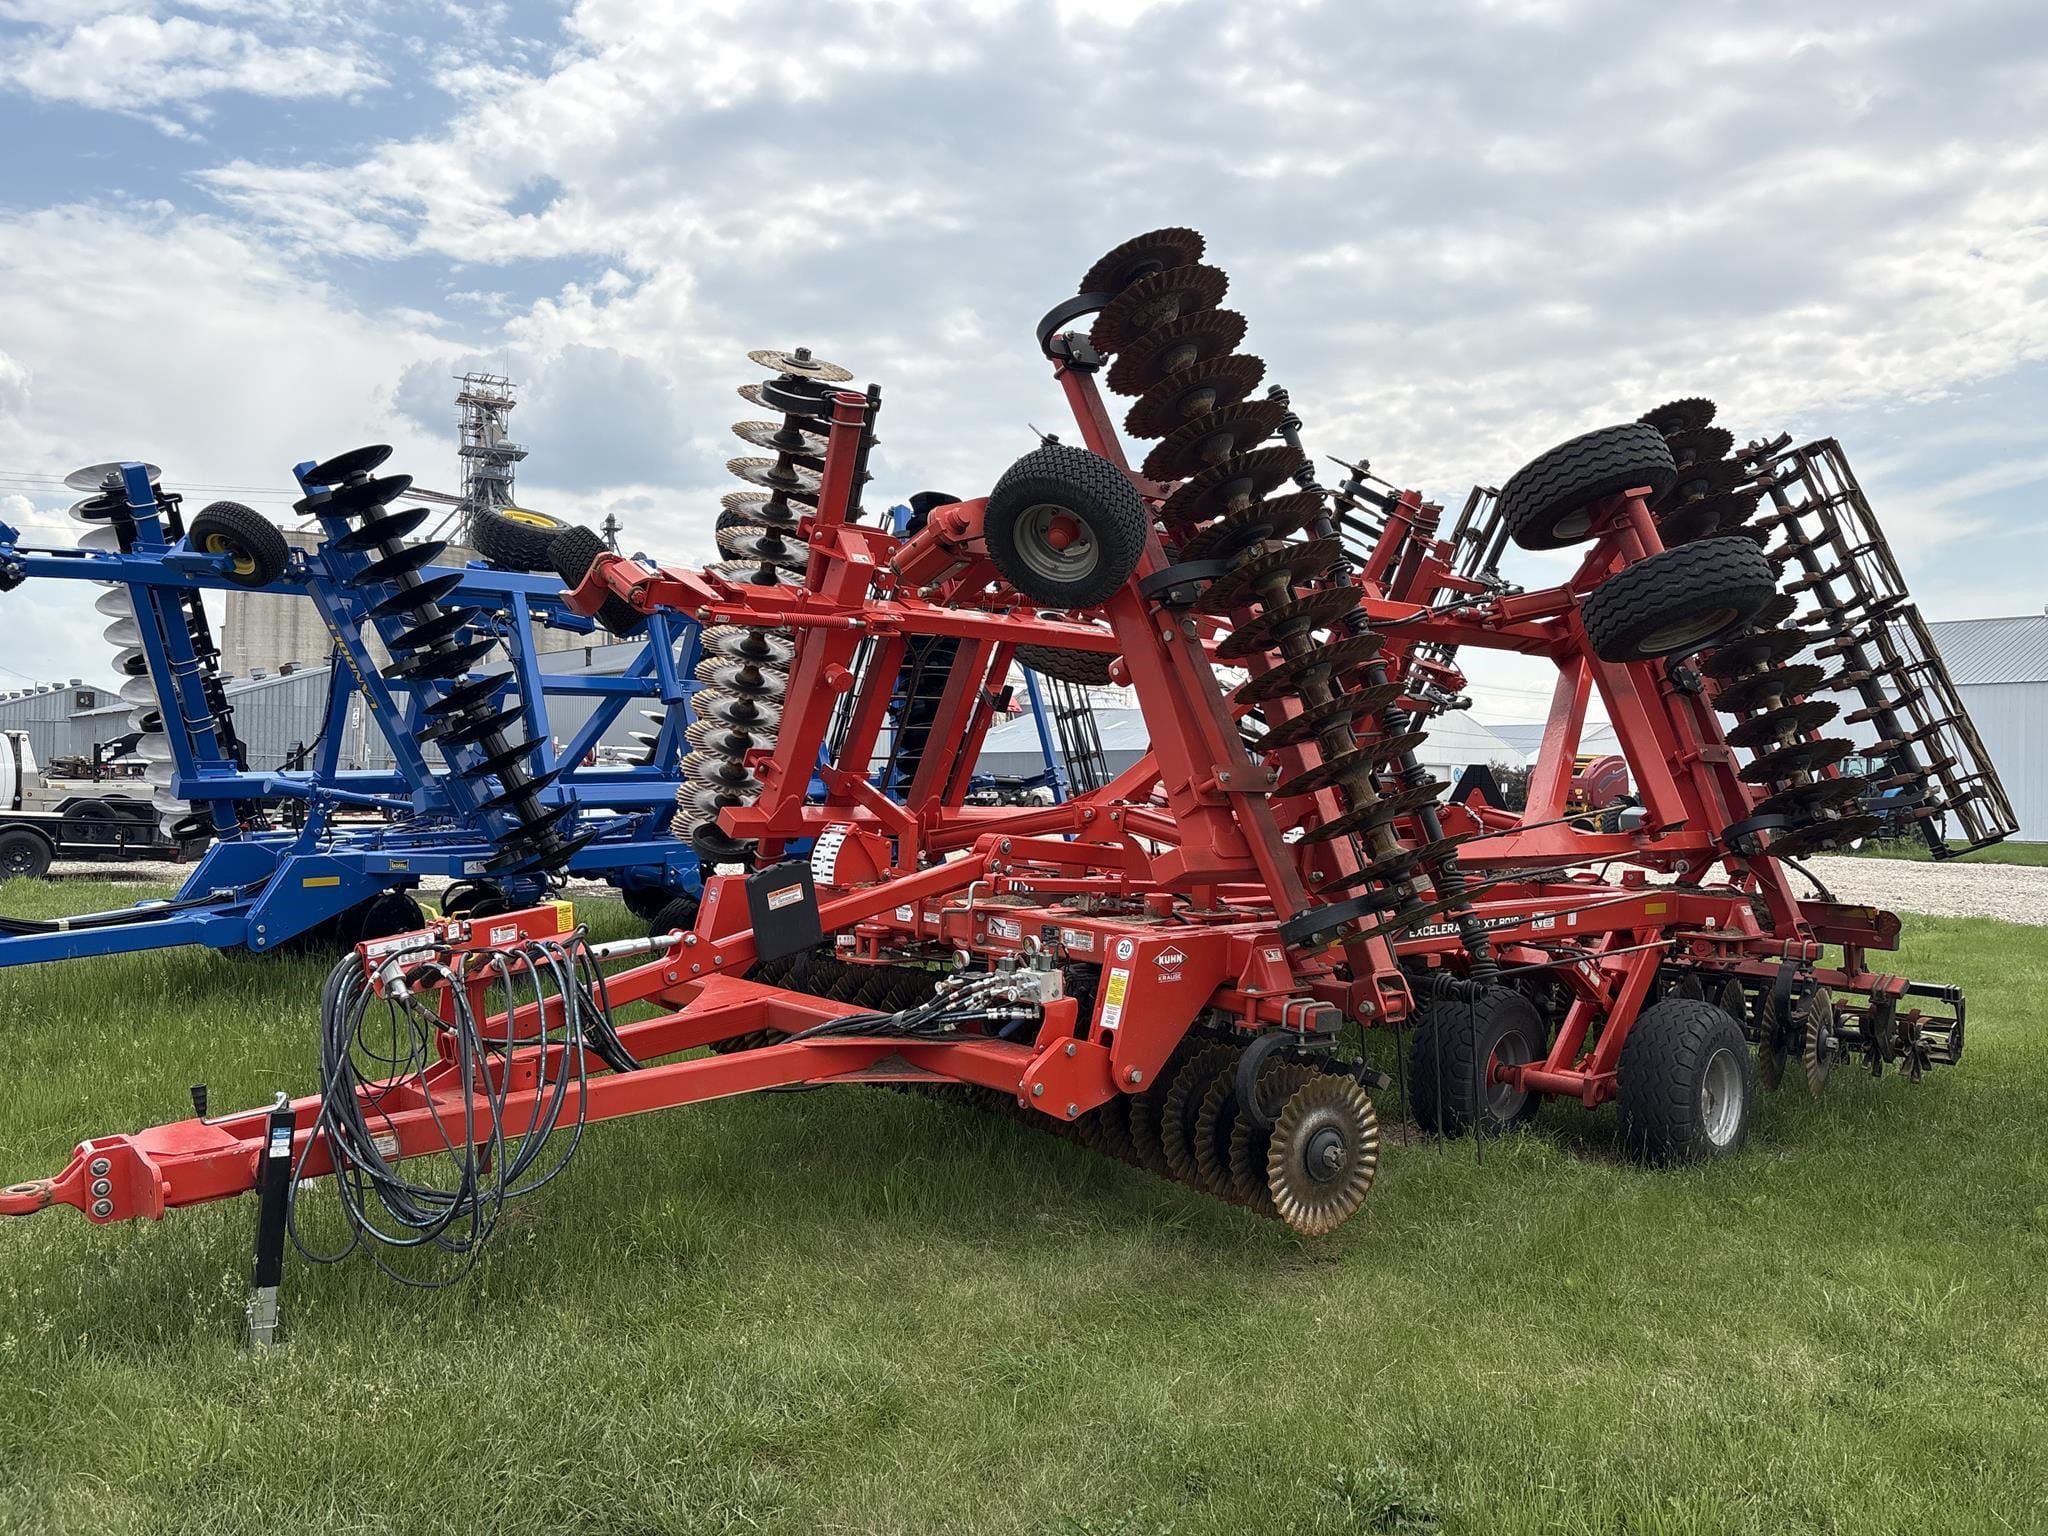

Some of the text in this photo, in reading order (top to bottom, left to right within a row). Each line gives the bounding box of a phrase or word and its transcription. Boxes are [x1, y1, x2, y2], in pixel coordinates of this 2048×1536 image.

[327, 619, 379, 709] LANDOLL
[1409, 920, 1481, 938] EXCELERA
[1483, 919, 1497, 929] XT
[1119, 943, 1131, 954] 20
[1158, 954, 1183, 965] KUHN
[1158, 973, 1182, 982] KRAUSE
